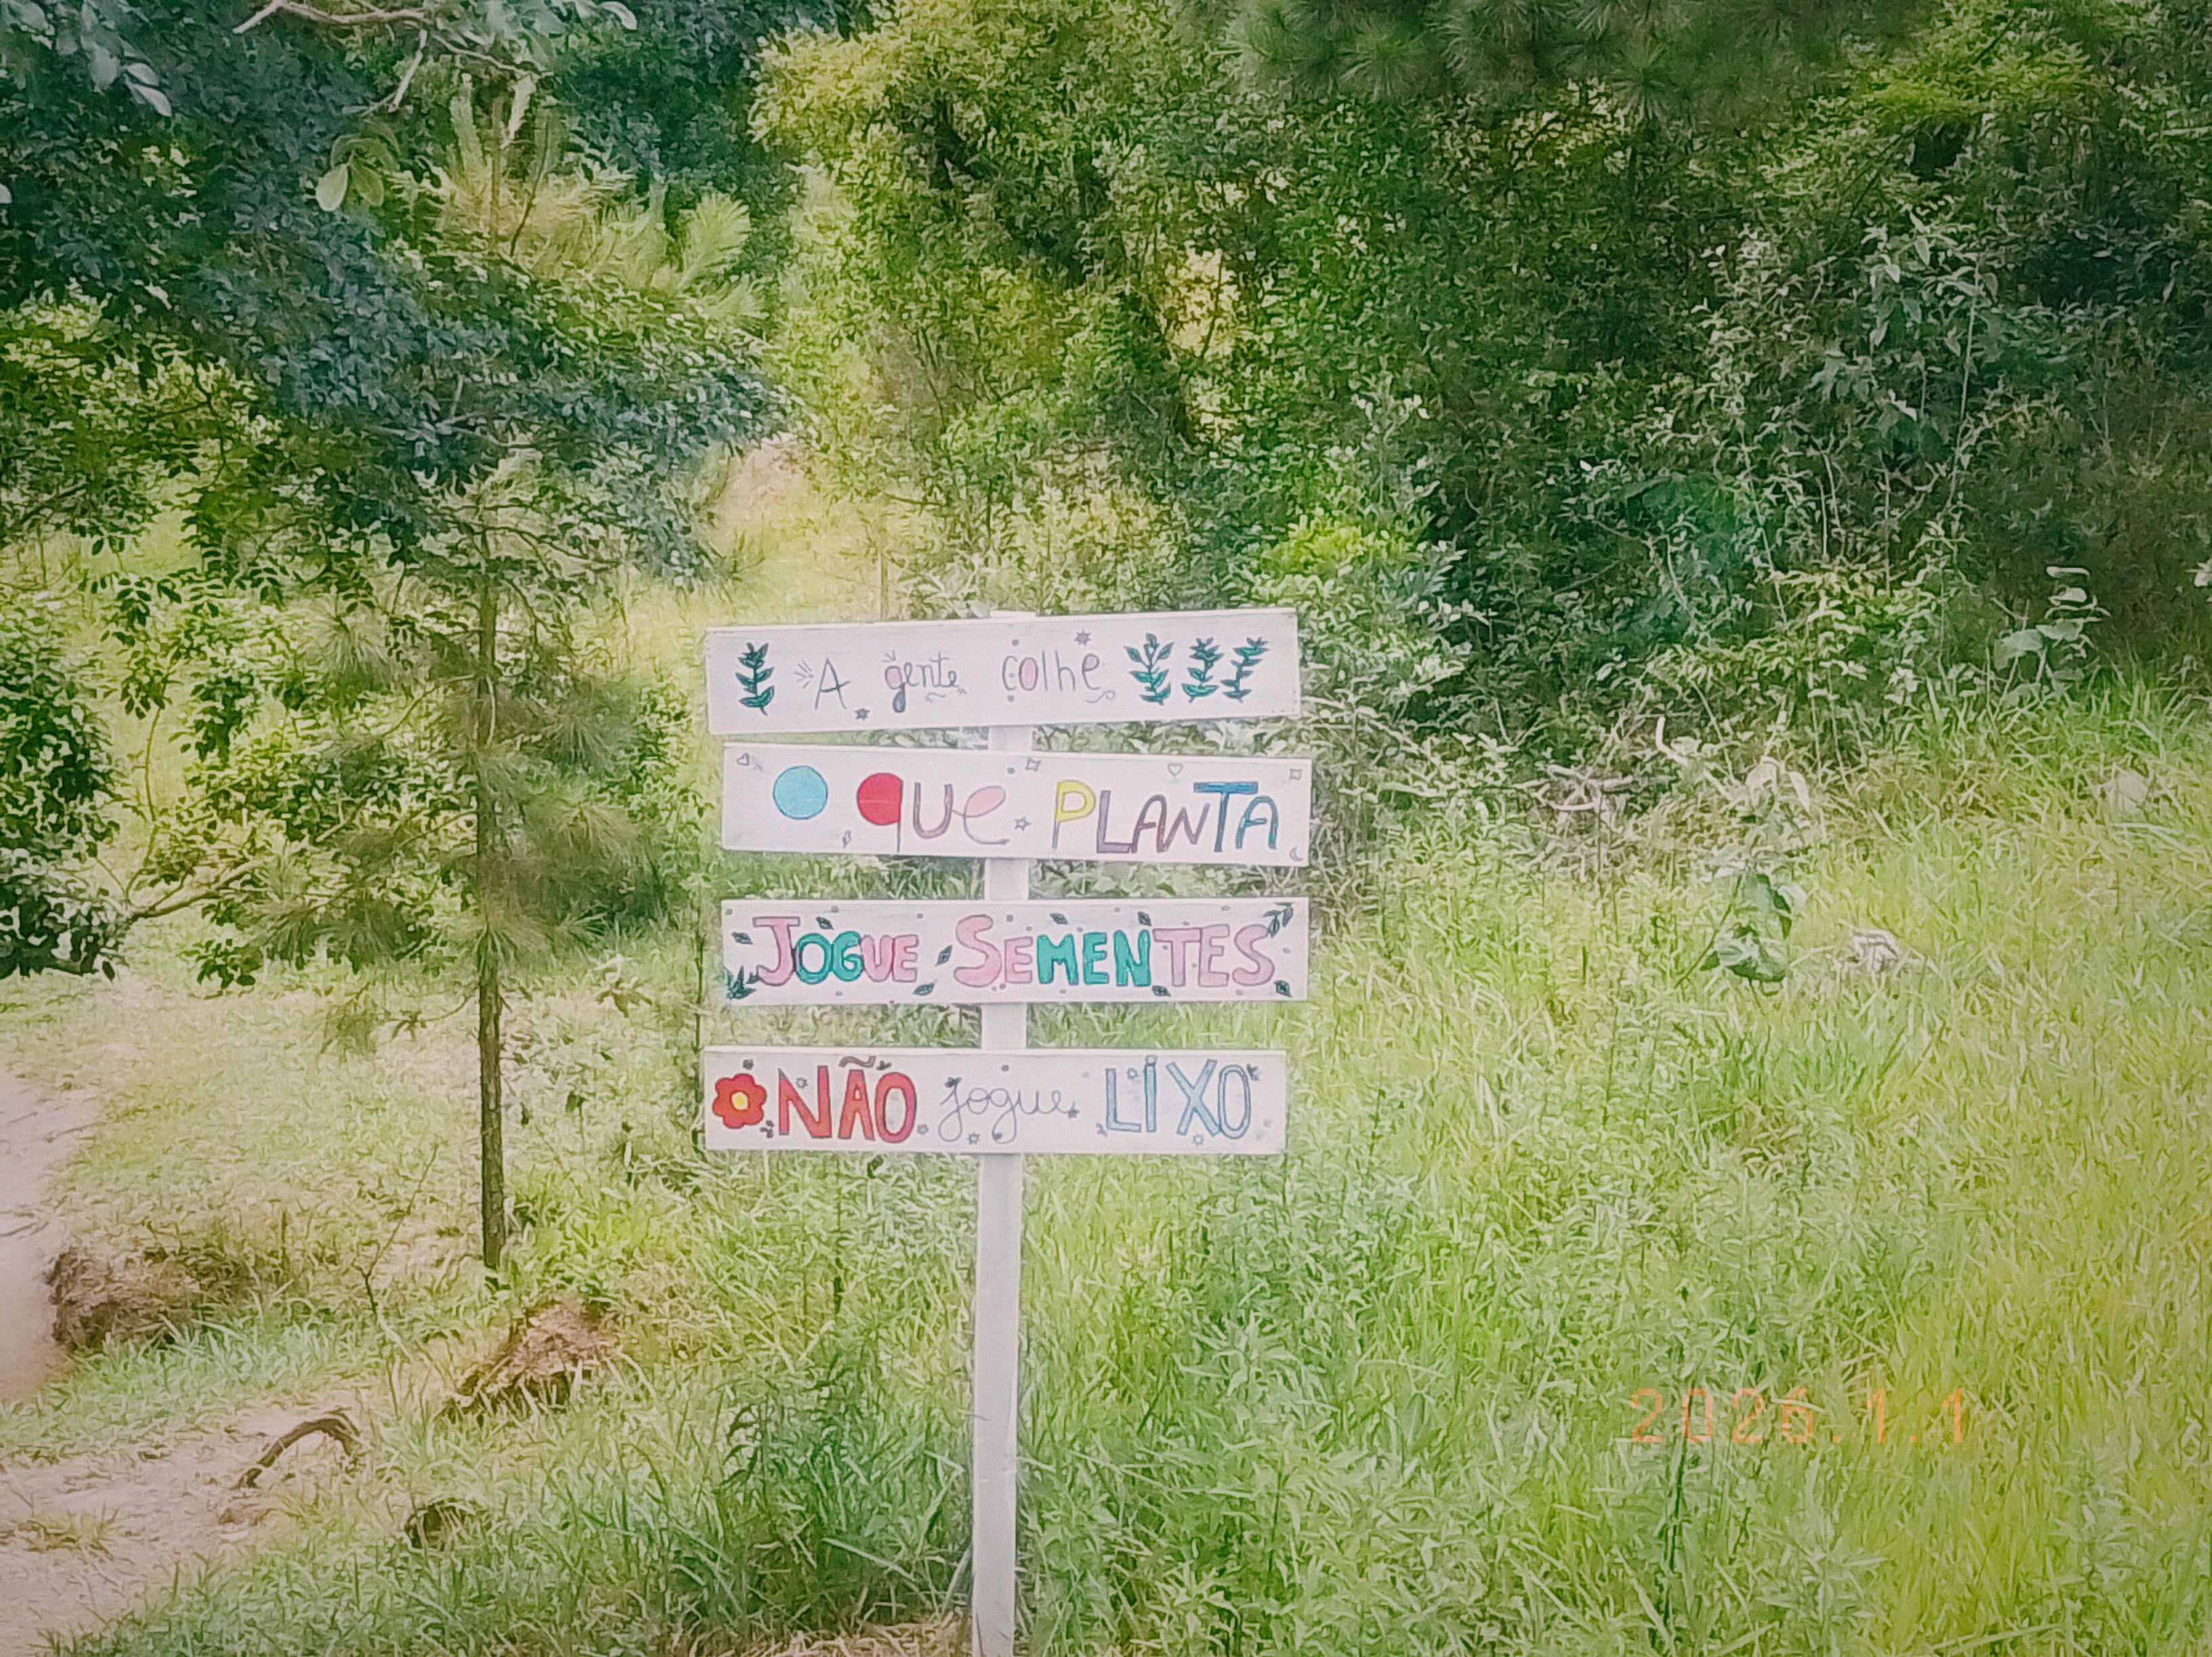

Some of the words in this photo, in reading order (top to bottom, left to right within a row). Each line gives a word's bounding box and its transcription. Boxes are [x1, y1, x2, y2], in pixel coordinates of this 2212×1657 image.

[815, 657, 851, 710] A
[884, 651, 958, 714] gente
[1002, 648, 1101, 692] colhe
[857, 772, 1010, 853] que
[1052, 779, 1279, 855] PLANTA
[752, 916, 920, 987] JOGUE
[953, 914, 1276, 987] SEMENTES
[778, 1055, 917, 1143] NÃO
[938, 1082, 1072, 1144] jogue
